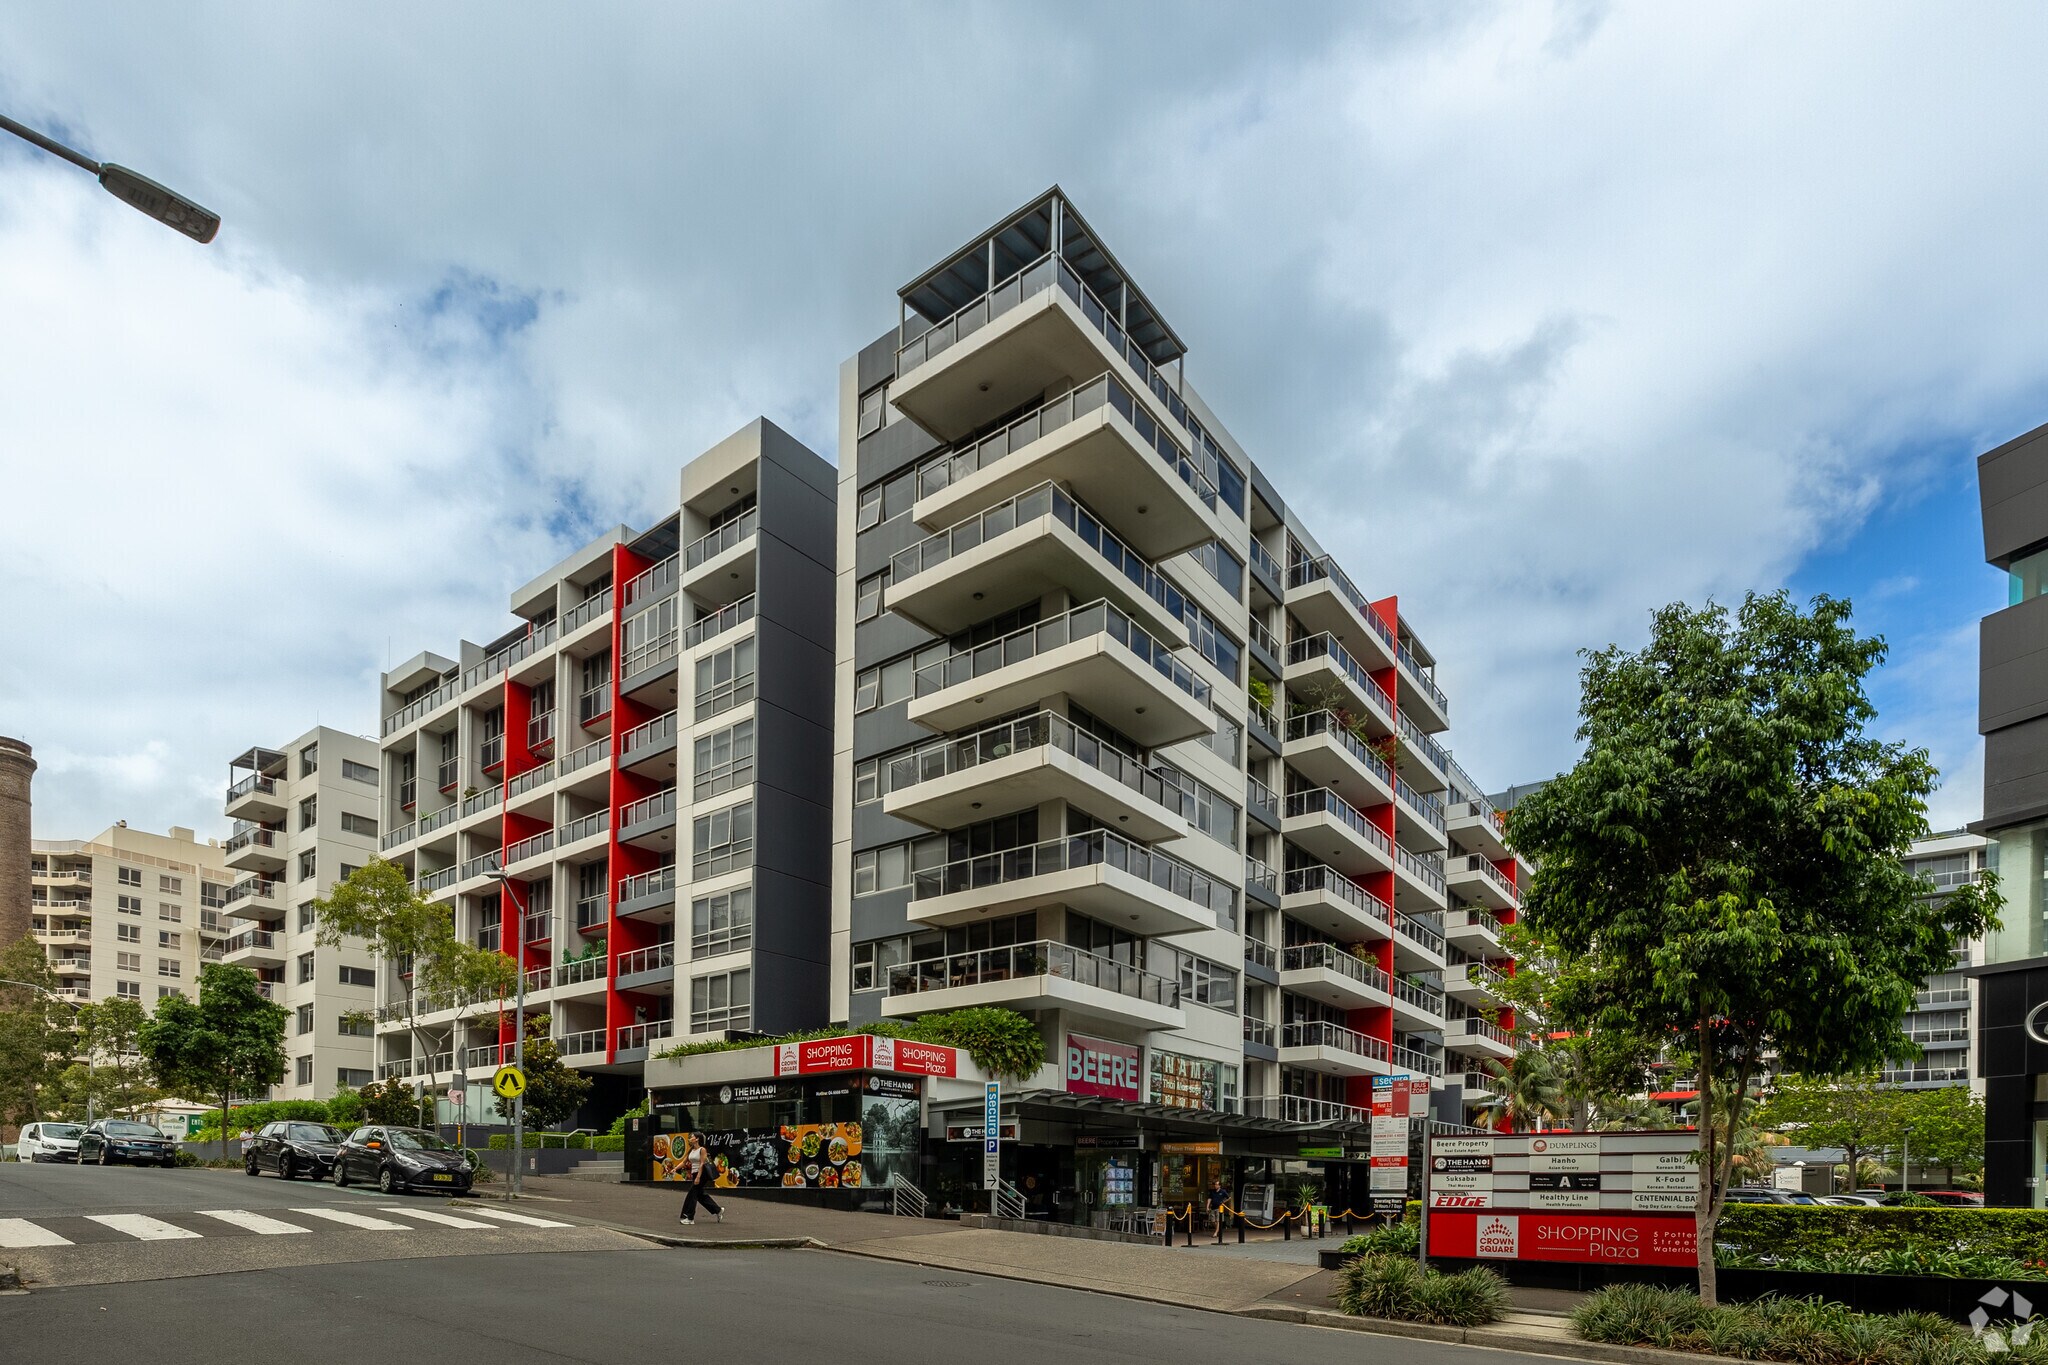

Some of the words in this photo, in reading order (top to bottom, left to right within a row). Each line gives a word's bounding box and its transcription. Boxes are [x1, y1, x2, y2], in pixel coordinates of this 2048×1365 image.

[806, 1044, 852, 1059] SHOPPING
[902, 1048, 946, 1062] SHOPPING
[830, 1056, 852, 1068] Plaza
[925, 1064, 946, 1074] Plaza
[1068, 1046, 1138, 1089] BEERE
[1164, 1055, 1200, 1079] NAM
[734, 1087, 749, 1096] THE
[750, 1085, 776, 1096] HANOI
[988, 1093, 996, 1135] secure
[988, 1141, 995, 1151] P
[1559, 1176, 1571, 1187] A
[1435, 1197, 1487, 1207] EDGE
[1537, 1226, 1638, 1242] SHOPPING
[1590, 1243, 1639, 1258] Plaza
